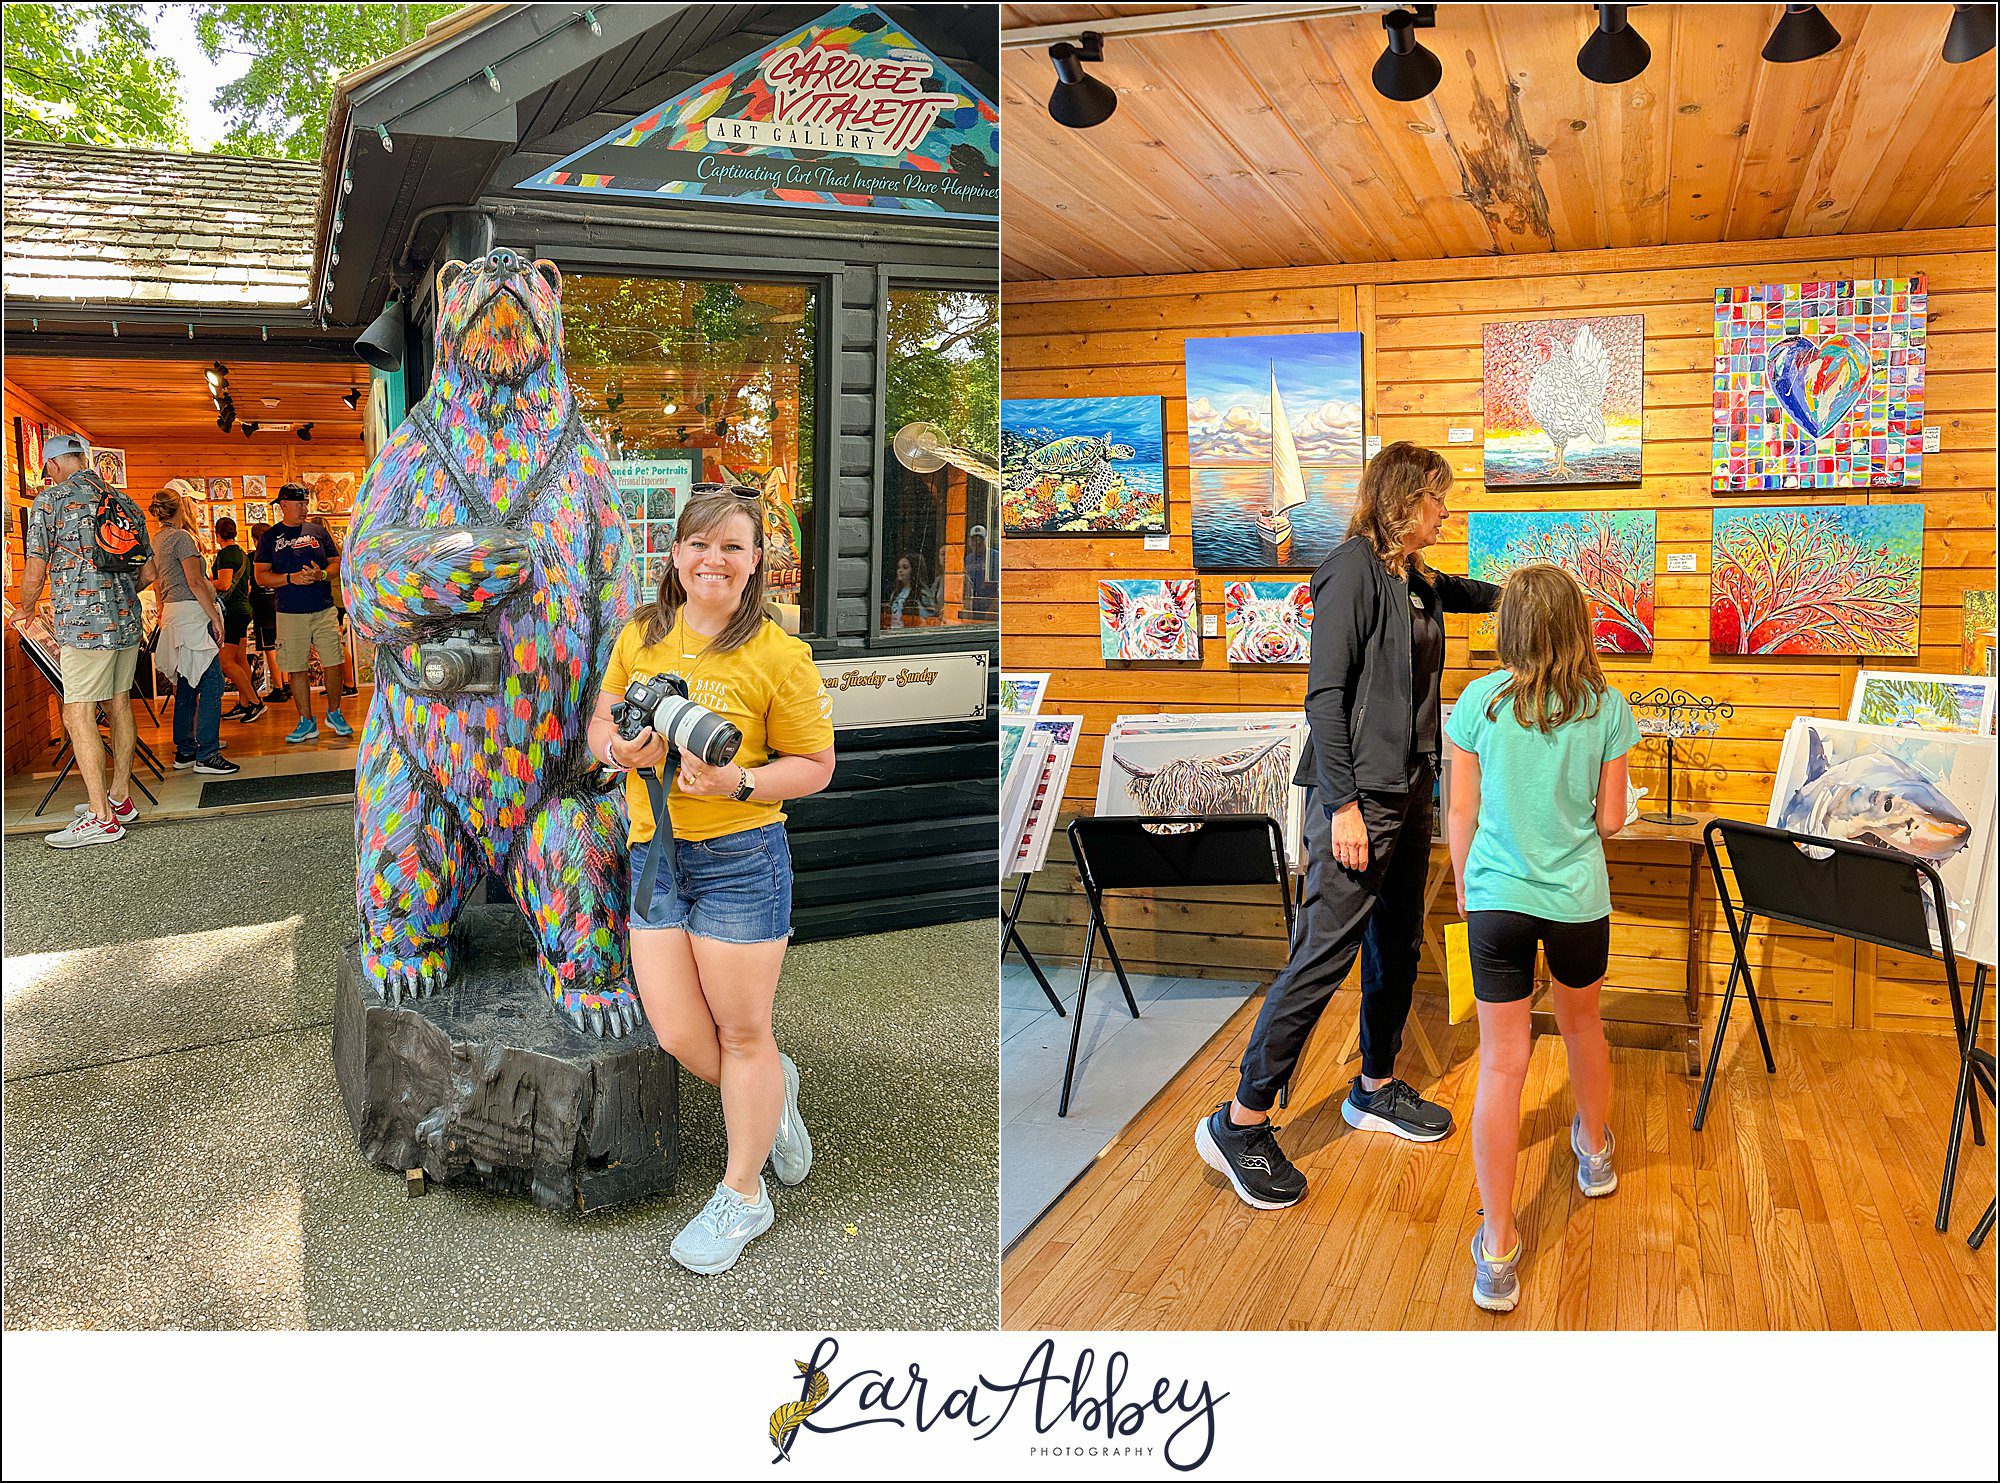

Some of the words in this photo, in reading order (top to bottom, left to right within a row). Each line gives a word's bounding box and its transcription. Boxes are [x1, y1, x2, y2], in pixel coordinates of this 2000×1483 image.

[769, 51, 930, 93] CAROLEE
[716, 122, 759, 139] ART
[773, 127, 875, 150] GALLERY
[697, 155, 782, 188] Captivating
[786, 164, 812, 184] Art
[815, 167, 850, 187] That
[853, 173, 900, 193] Inspires
[903, 175, 938, 194] Pure
[635, 466, 649, 476] Pet
[652, 466, 688, 476] Portraits
[695, 679, 728, 697] BASIS
[840, 669, 886, 691] Tuesday
[896, 667, 938, 688] Sunday
[688, 691, 729, 713] OASTER
